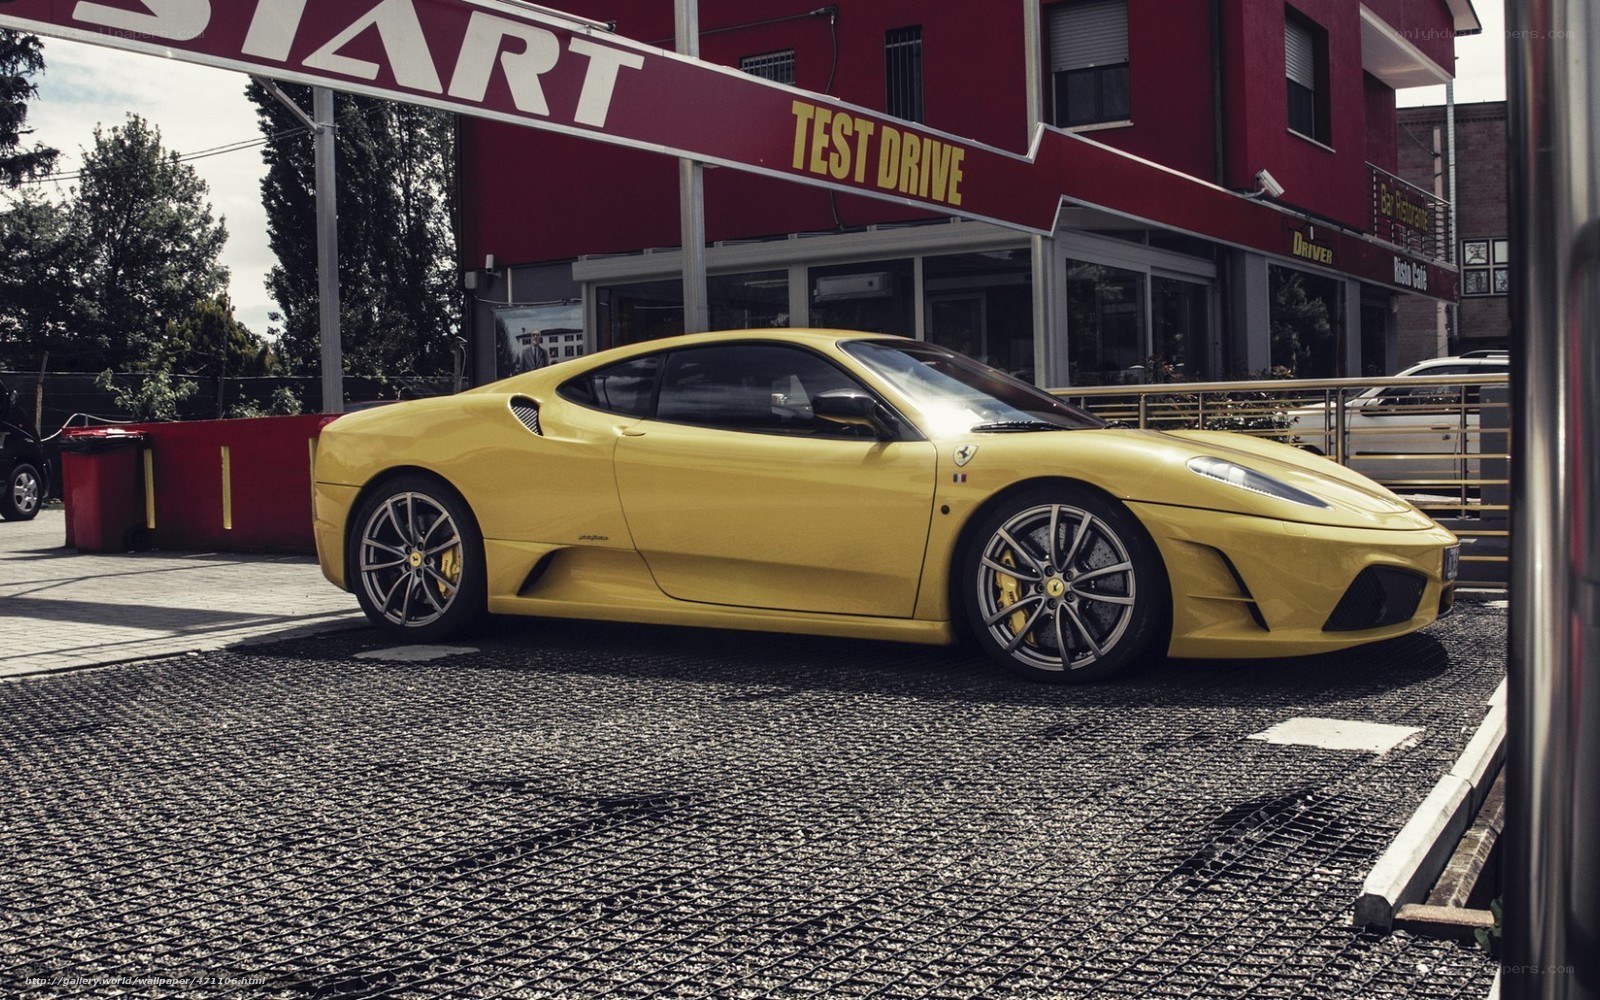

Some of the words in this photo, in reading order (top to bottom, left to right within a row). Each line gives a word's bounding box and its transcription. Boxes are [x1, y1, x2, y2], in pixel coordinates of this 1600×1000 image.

[792, 100, 874, 183] TEST
[877, 125, 965, 206] DRIVE
[1381, 183, 1393, 216] Bar
[1293, 231, 1333, 265] DRIVER
[1394, 256, 1411, 287] Risto
[1412, 262, 1427, 291] Café
